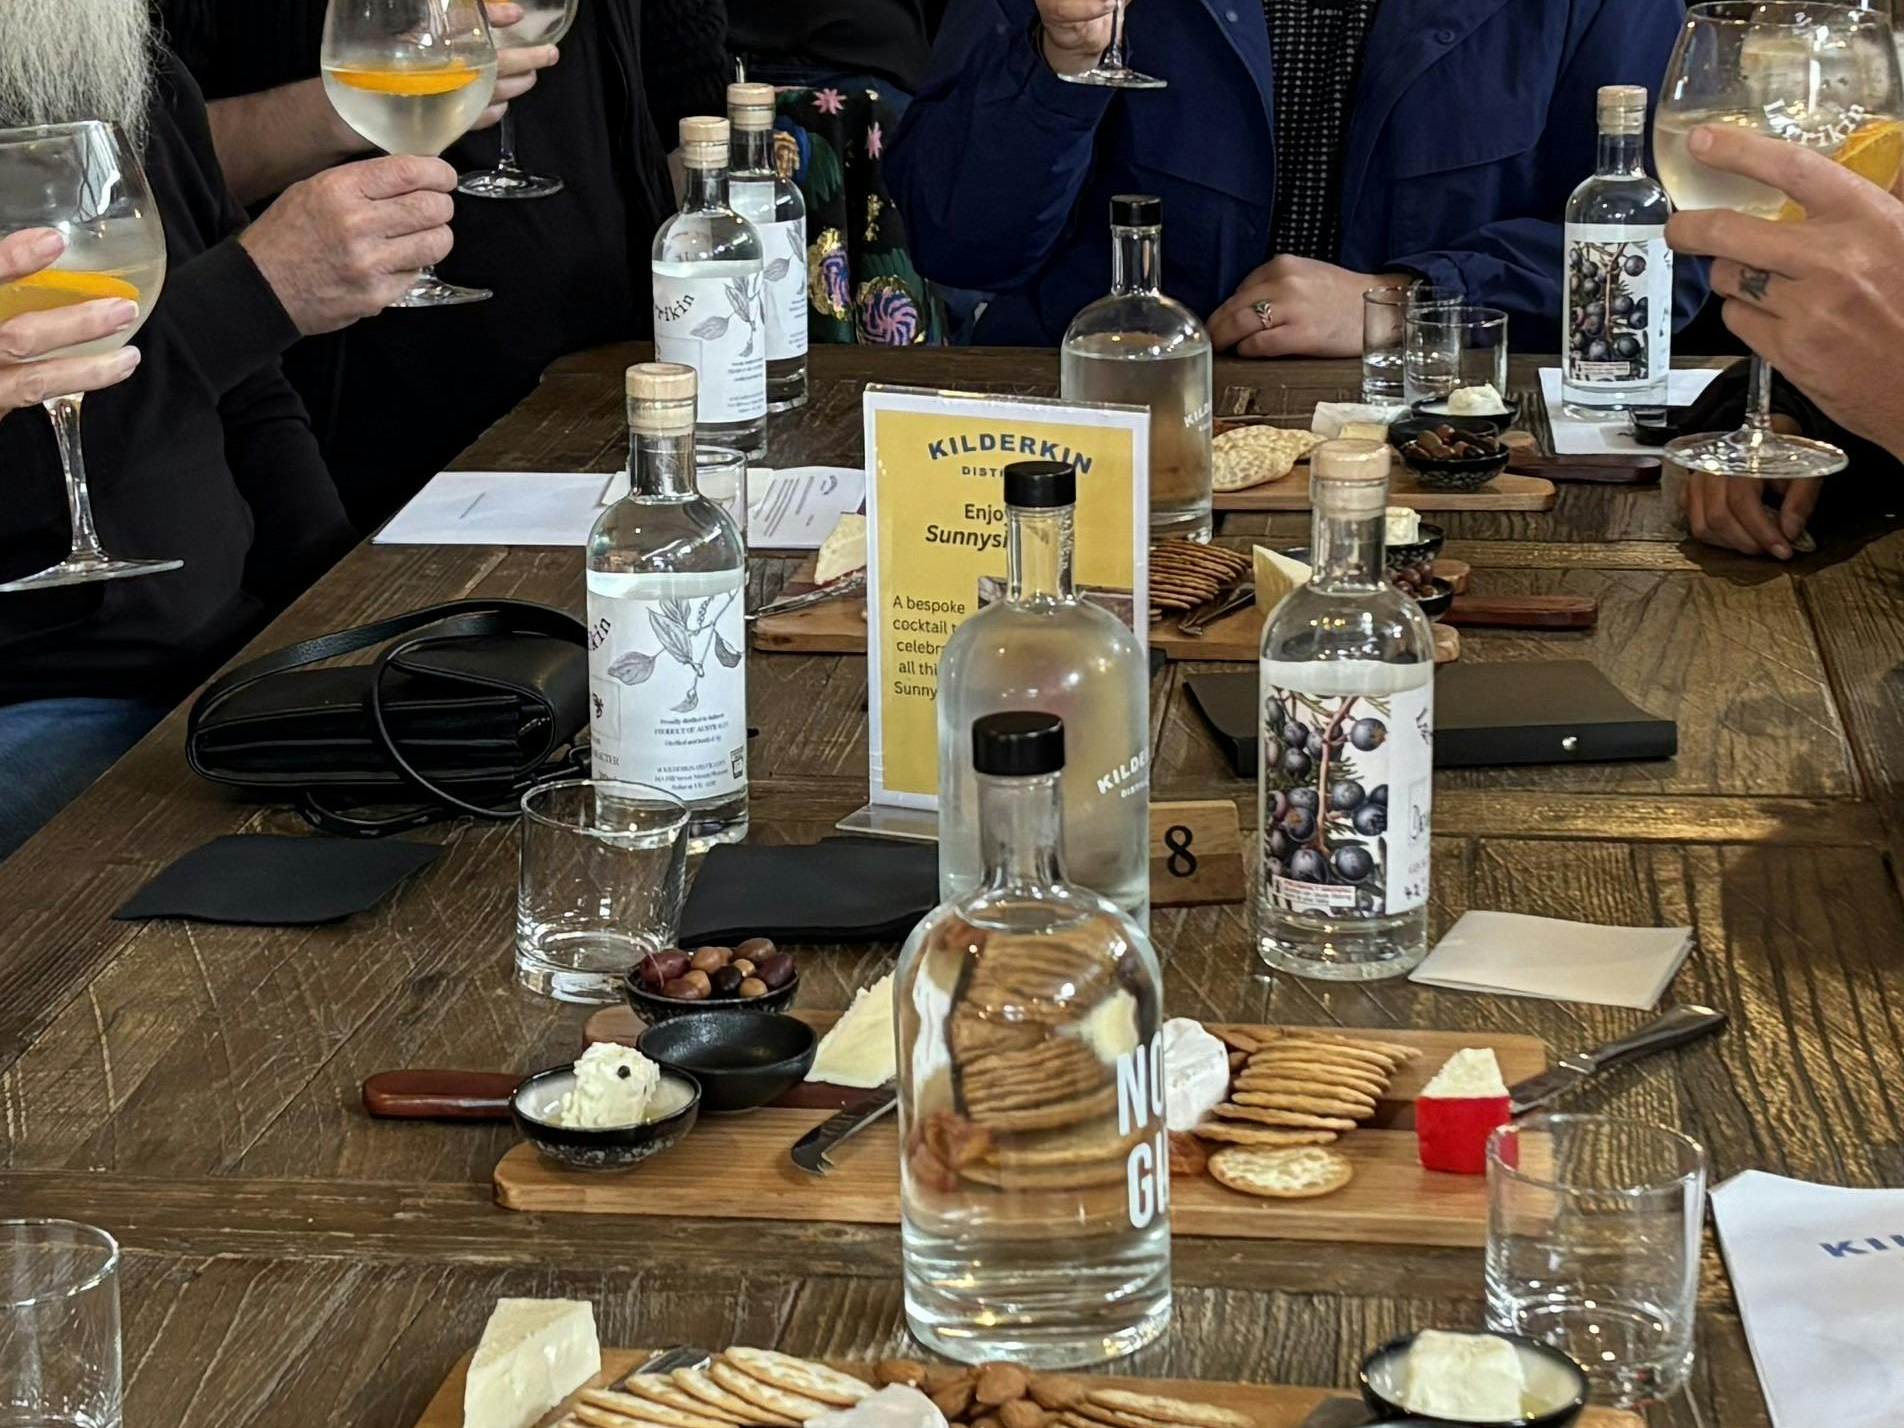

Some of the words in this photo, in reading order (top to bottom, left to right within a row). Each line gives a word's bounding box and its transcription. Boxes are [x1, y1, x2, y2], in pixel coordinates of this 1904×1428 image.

[928, 434, 1092, 474] KILDERKIN
[962, 466, 1004, 477] DISTI
[965, 504, 1008, 526] Enjo
[925, 525, 1008, 551] Sunnysi
[893, 596, 903, 609] A
[907, 596, 965, 614] bespoke
[893, 619, 947, 634] cocktail
[896, 640, 946, 655] celebr
[899, 660, 915, 675] all
[919, 662, 937, 676] thi
[894, 681, 937, 701] Sunny
[1165, 825, 1197, 878] 8
